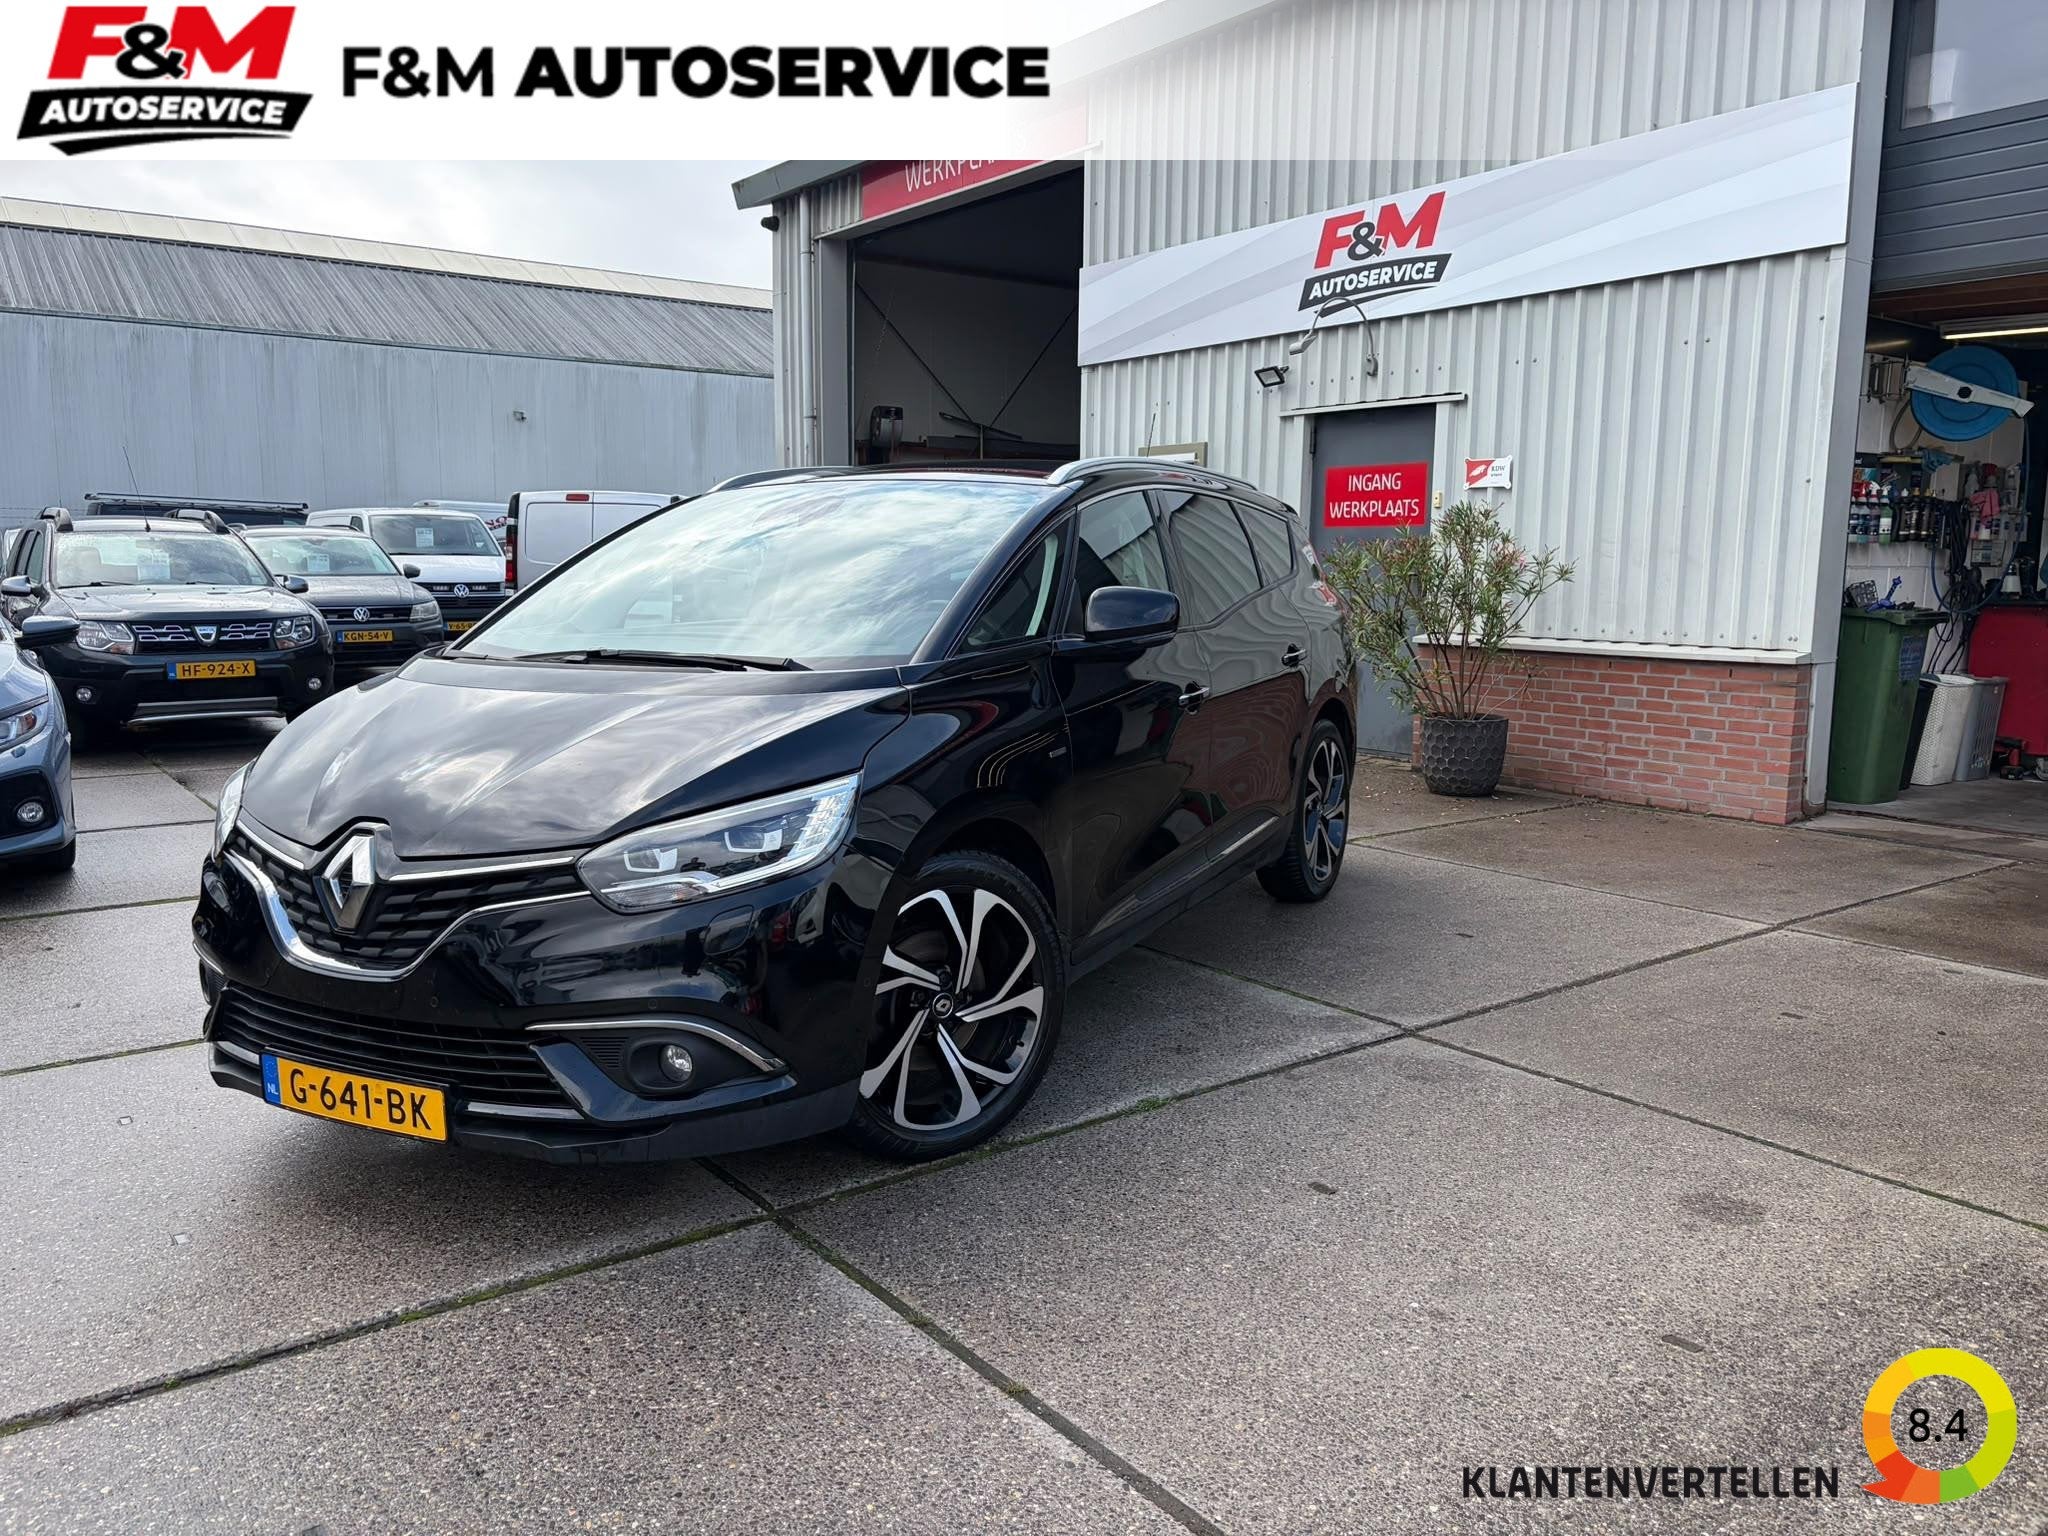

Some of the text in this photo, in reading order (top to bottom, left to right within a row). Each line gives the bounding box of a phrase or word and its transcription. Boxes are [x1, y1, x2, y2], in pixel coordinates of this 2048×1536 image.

[1314, 191, 1447, 269] F&M
[1308, 260, 1437, 300] AUTOSERVICE
[1347, 472, 1402, 492] INGANG
[1329, 498, 1420, 519] WERKPLAATS
[343, 630, 389, 641] KGN-54-V
[181, 663, 250, 677] HF-924-X
[290, 1068, 432, 1130] G-641-BK
